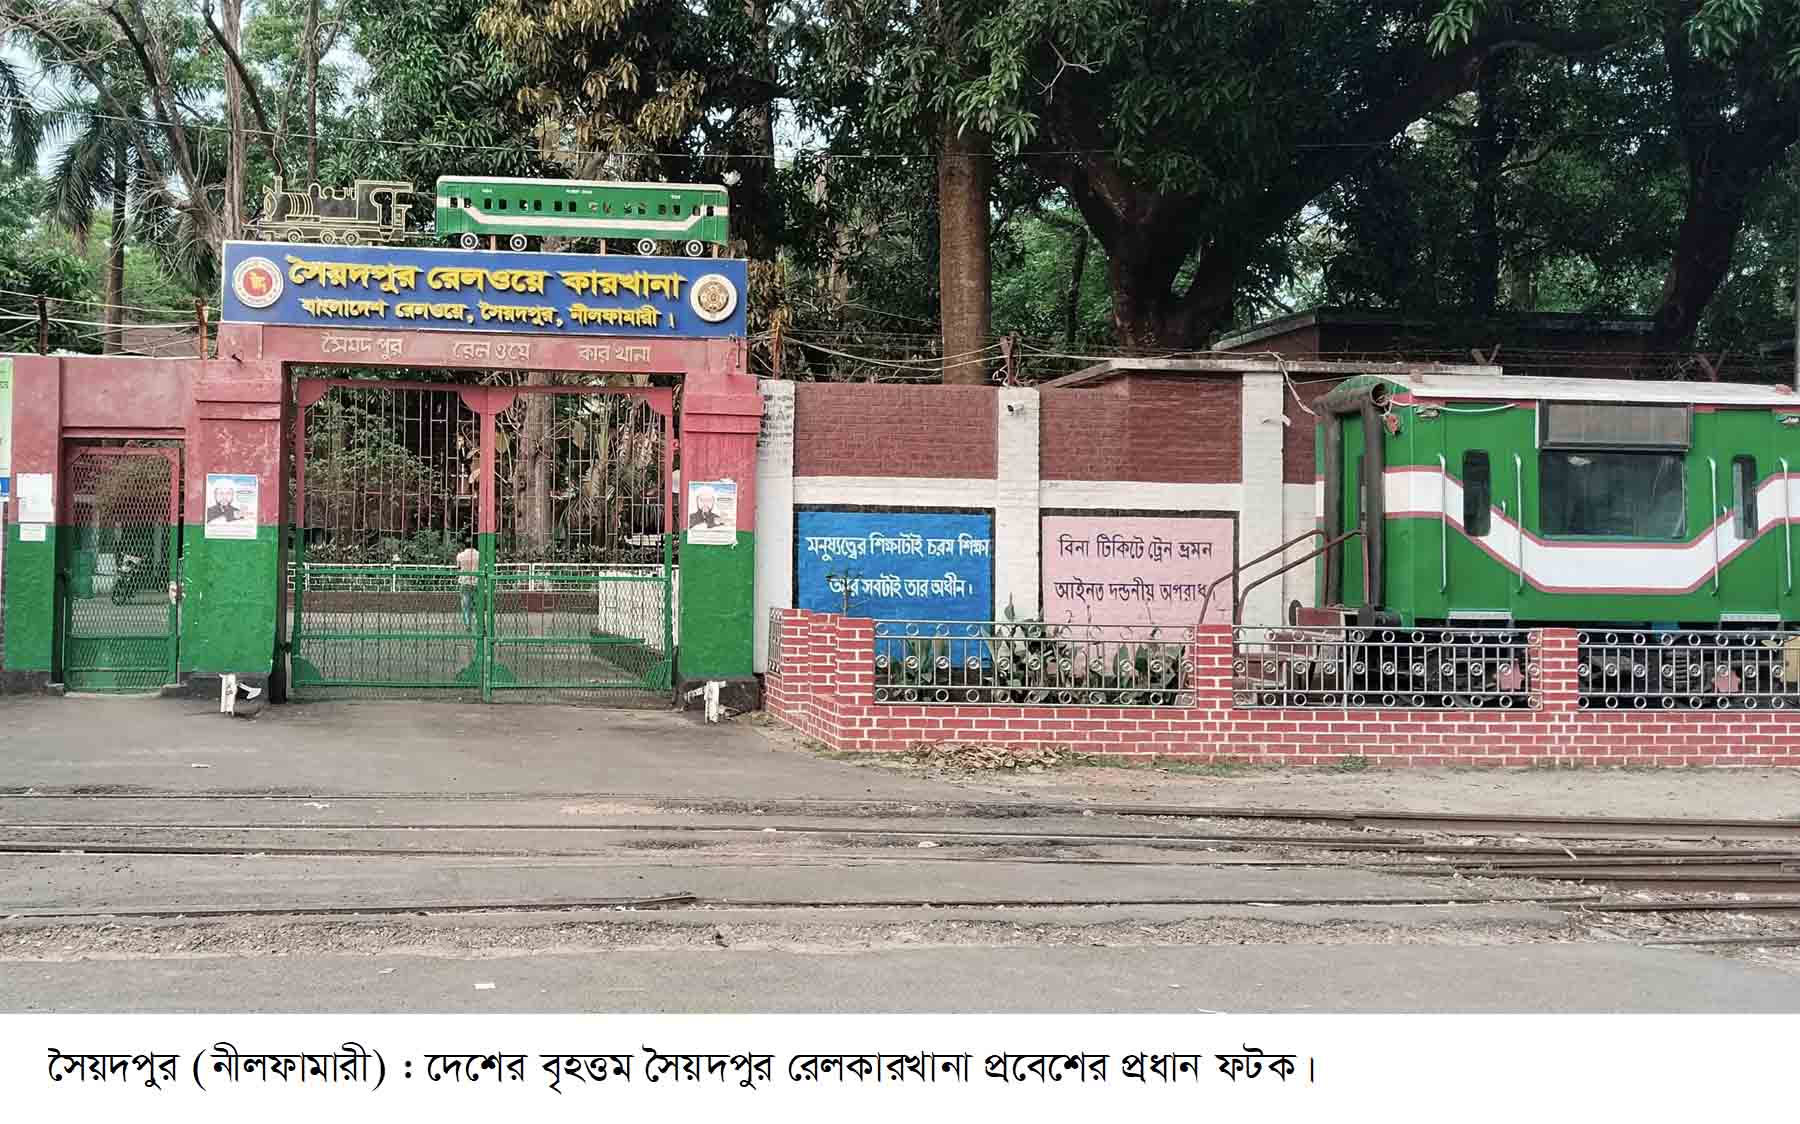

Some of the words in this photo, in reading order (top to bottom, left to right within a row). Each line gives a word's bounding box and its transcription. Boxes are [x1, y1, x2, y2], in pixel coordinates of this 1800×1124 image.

[286, 254, 423, 294] সৈয়দপুর
[427, 264, 554, 296] রেলওয়ে
[557, 269, 689, 300] কারখানা
[298, 297, 390, 318] বাংলাদেশ
[868, 532, 923, 557] শিক্ষাটাই
[926, 538, 954, 557] চরম
[957, 533, 991, 557] শিক্ষা
[1057, 533, 1089, 558] বিনা
[1096, 533, 1145, 559] টিকিটে
[1147, 536, 1173, 562] ট্রেন
[1177, 541, 1213, 561] ভ্রমন
[861, 571, 903, 599] সবটাই
[904, 579, 930, 598] তার
[1054, 575, 1104, 602] আইনত
